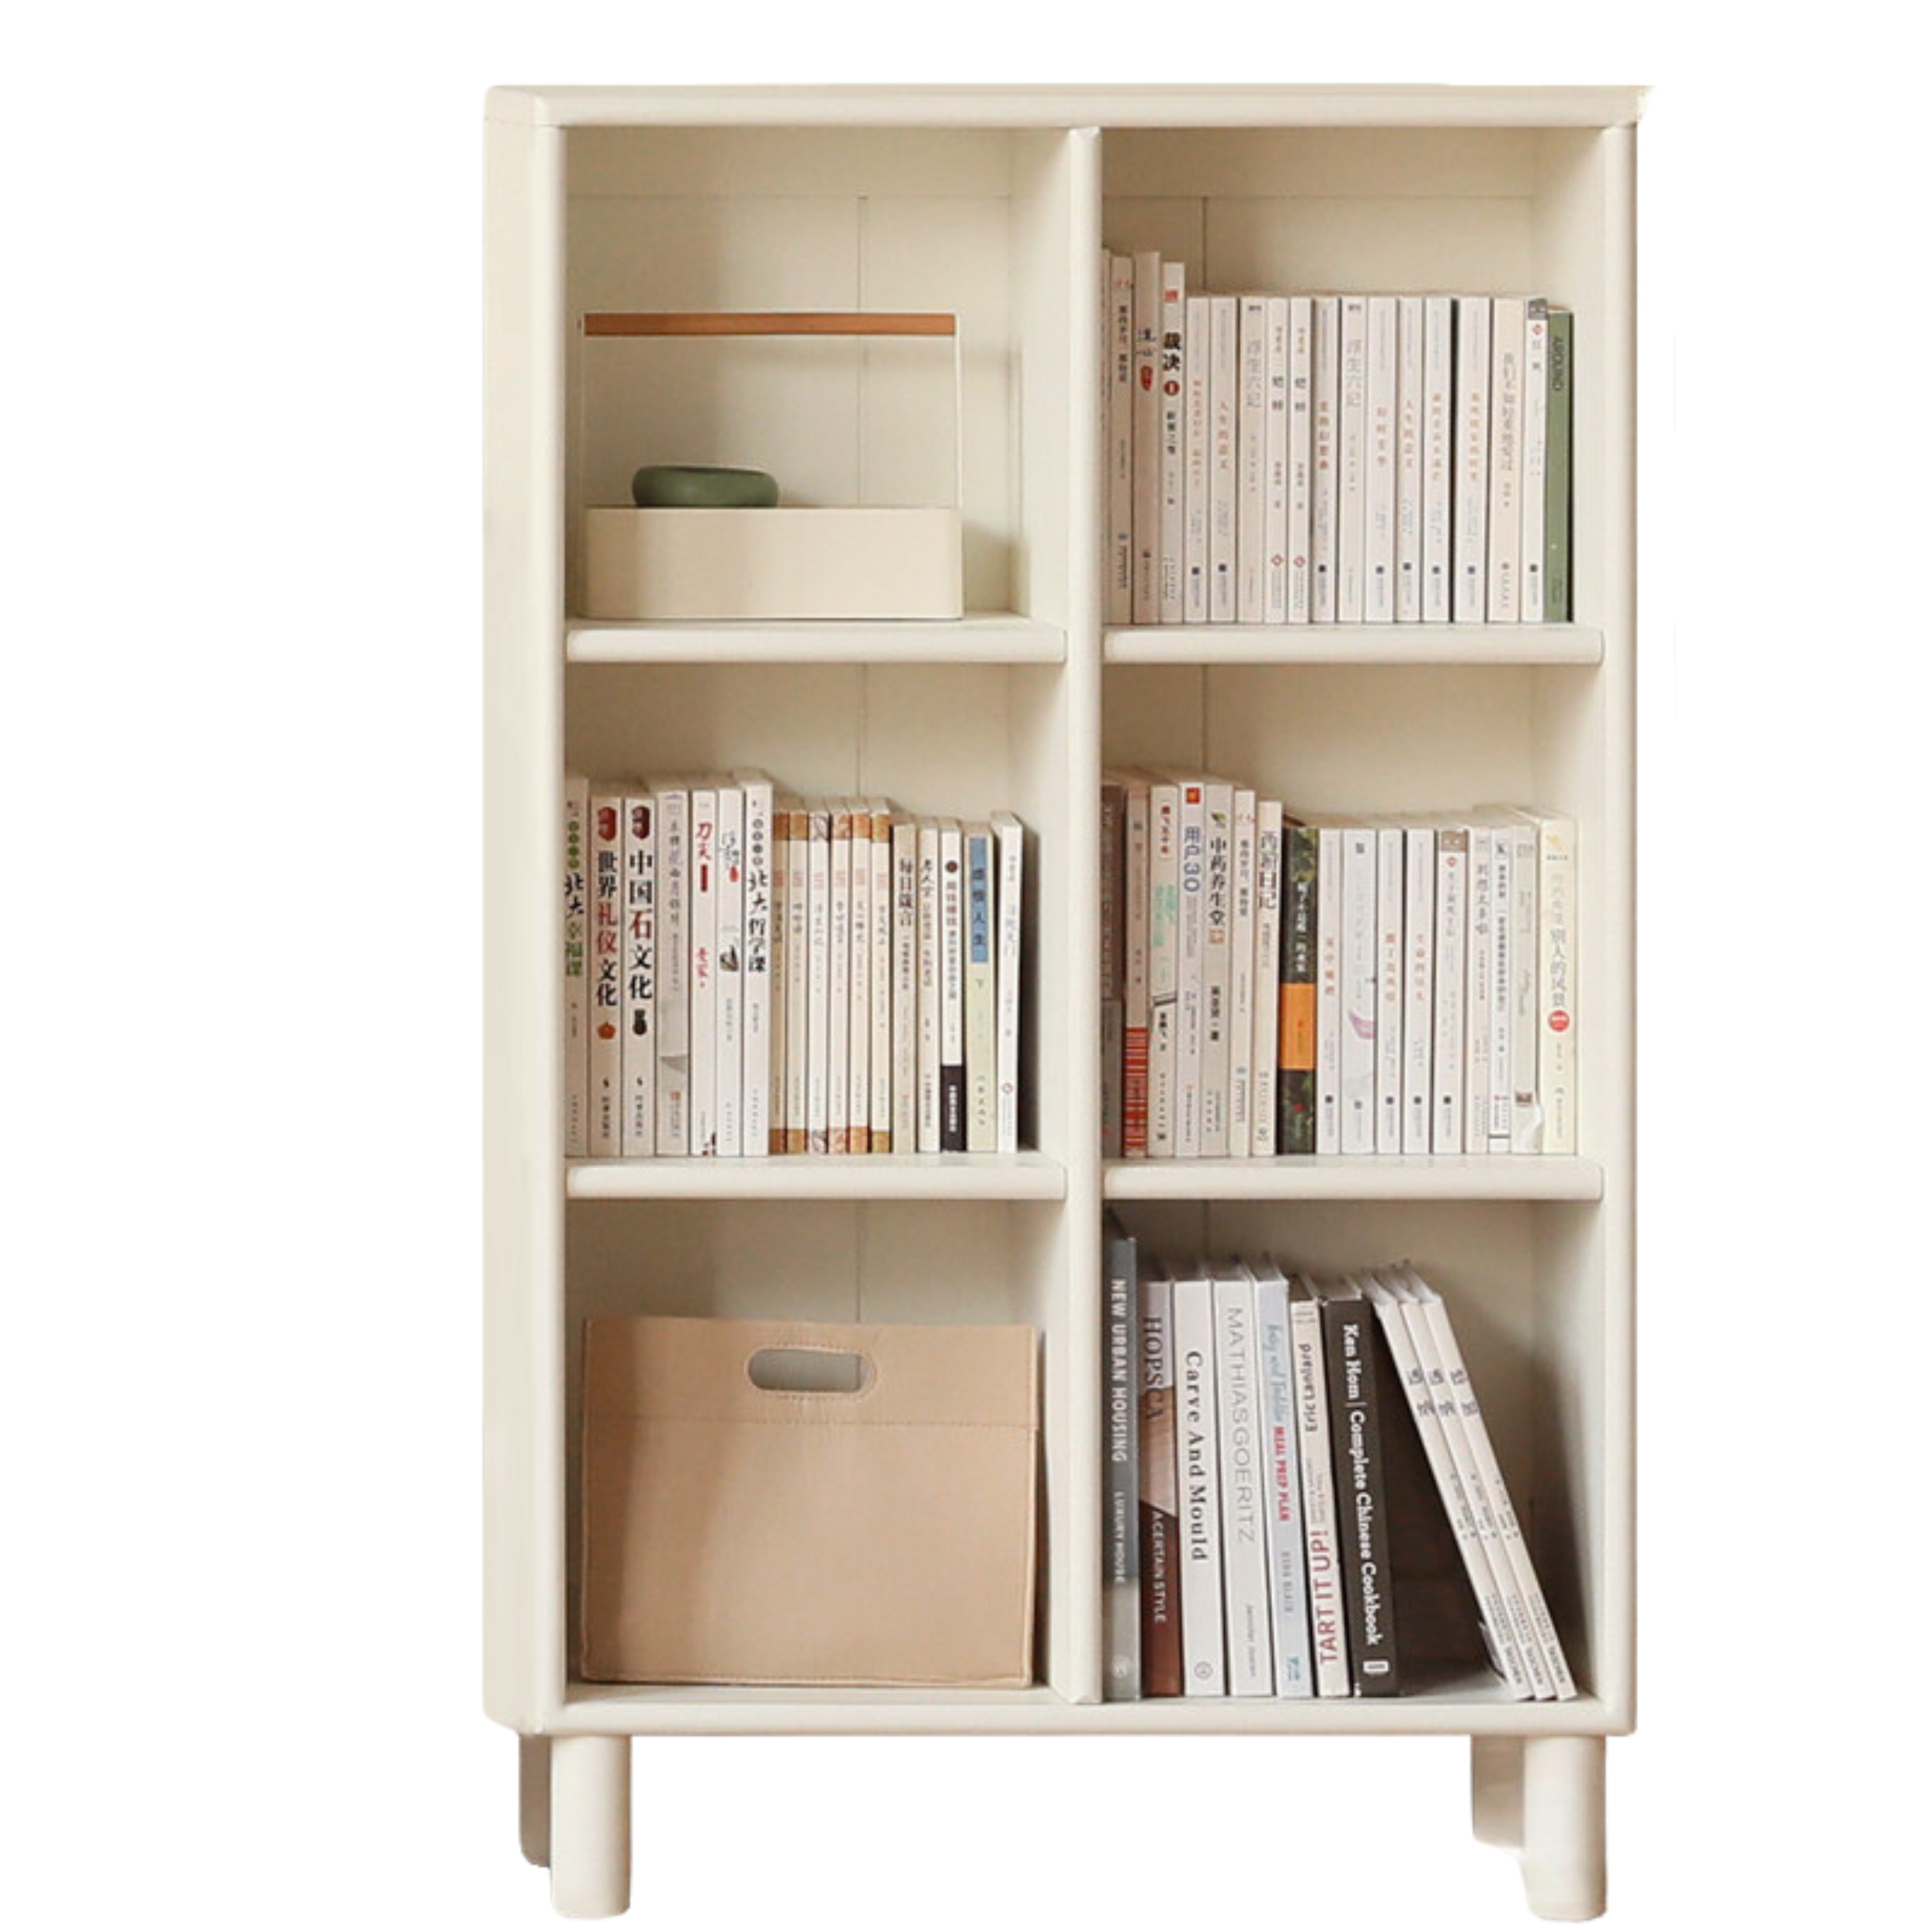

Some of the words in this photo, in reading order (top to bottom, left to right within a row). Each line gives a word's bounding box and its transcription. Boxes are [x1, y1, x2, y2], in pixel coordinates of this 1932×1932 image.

[596, 851, 618, 1006] 世界礼仪文化
[629, 850, 653, 1000] 中国石文化
[1111, 1279, 1128, 1317] NEW
[1111, 1323, 1127, 1381] URBAN
[1144, 1317, 1163, 1420] HOPSCA
[1344, 1324, 1360, 1357] Ken
[1186, 1351, 1203, 1423] Carve
[1298, 1343, 1315, 1400] Lanlard
[1345, 1360, 1362, 1400] Hom
[1111, 1387, 1127, 1461] HOUSING
[1274, 1427, 1285, 1455] MEAL
[1303, 1404, 1318, 1432] Eric
[1188, 1431, 1205, 1477] And
[1277, 1460, 1288, 1488] PREP
[1349, 1410, 1370, 1489] Complete
[1190, 1485, 1208, 1560] Mould
[1279, 1492, 1290, 1521] PLAN
[1356, 1492, 1373, 1559] Chinese
[1310, 1530, 1331, 1573] UP!
[1314, 1578, 1333, 1599] IT
[1361, 1562, 1384, 1646] Cookbook
[1317, 1606, 1337, 1664] TART
